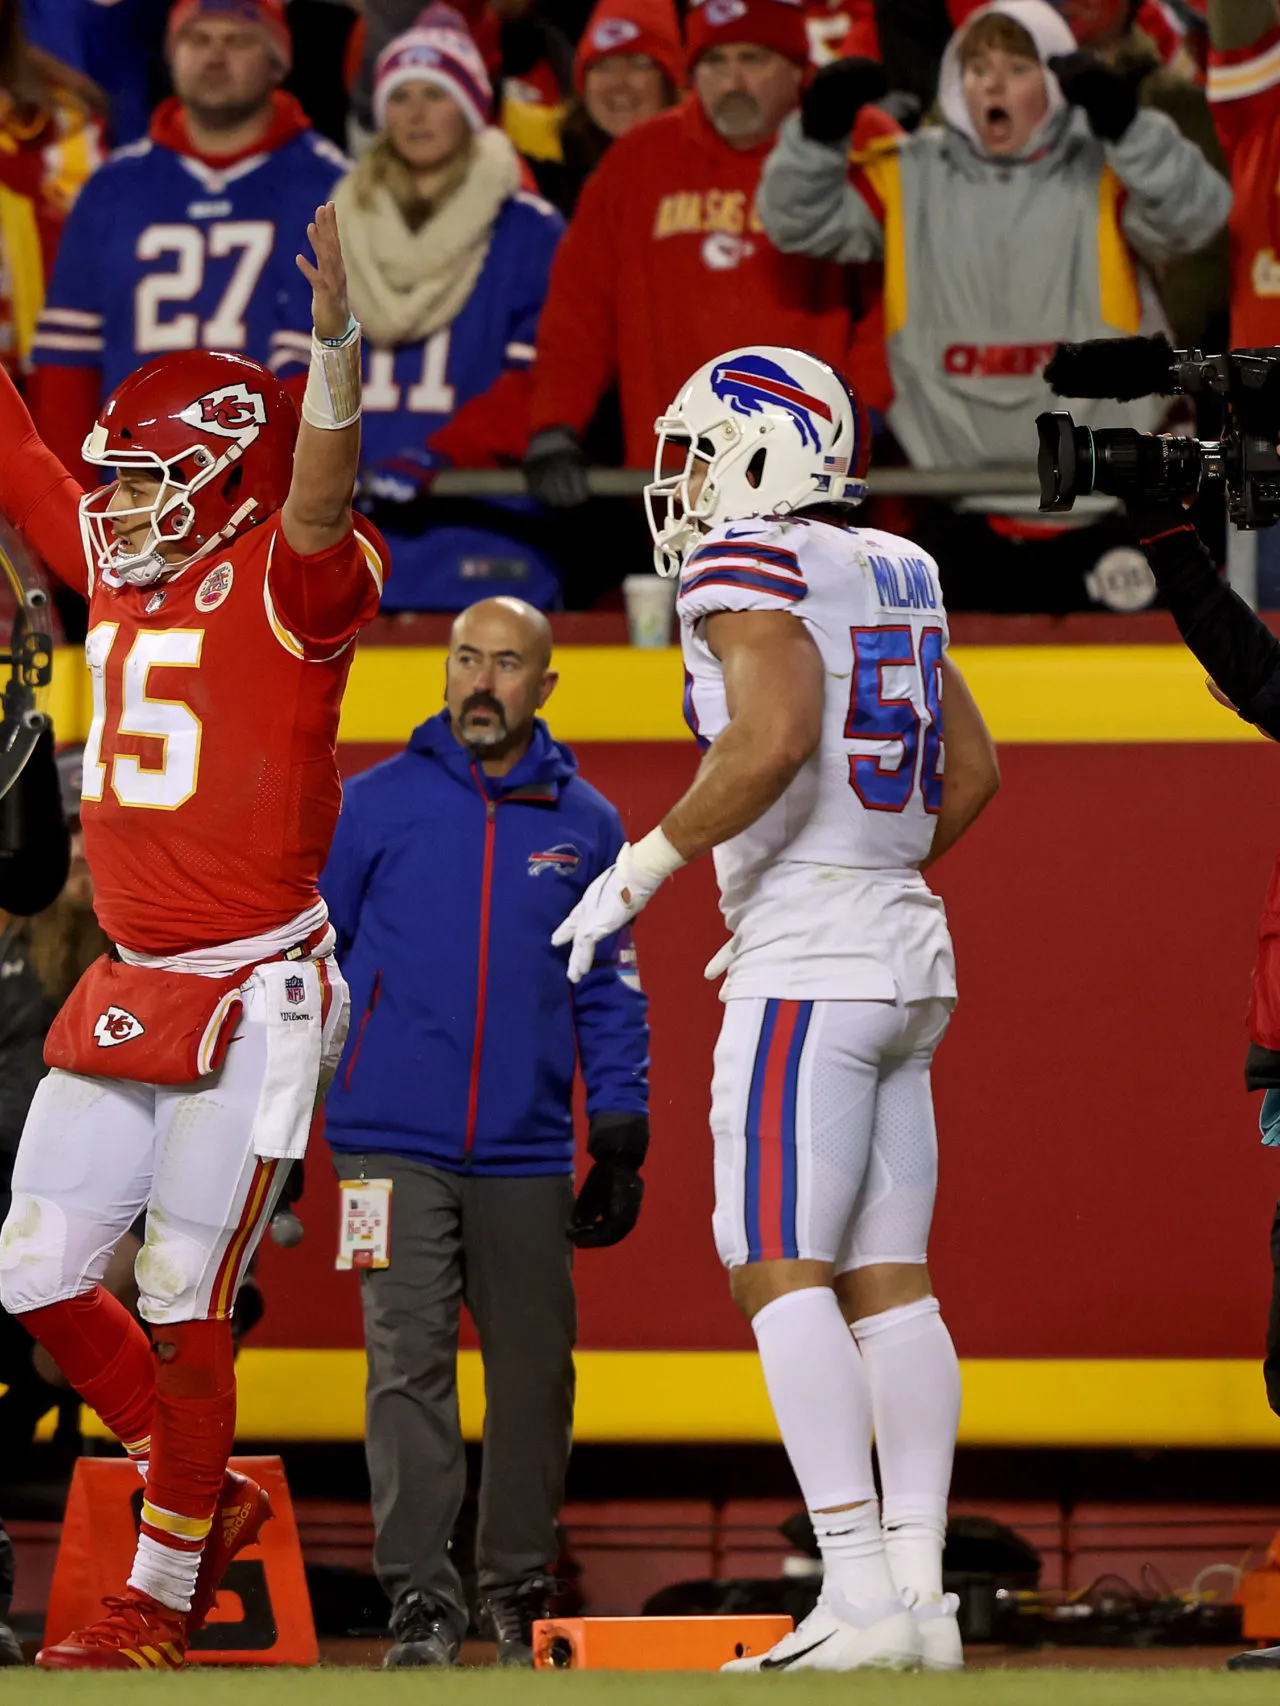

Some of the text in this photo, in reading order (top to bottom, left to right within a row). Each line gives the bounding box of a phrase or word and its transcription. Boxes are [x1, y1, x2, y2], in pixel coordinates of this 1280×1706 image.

[134, 220, 275, 353] 27
[942, 341, 1057, 376] CHIEF
[199, 395, 256, 430] KC
[867, 556, 937, 609] MILANO
[81, 620, 205, 811] 15
[287, 988, 304, 1001] NFL
[104, 1014, 133, 1040] KC
[280, 1011, 310, 1021] Wilson
[224, 1502, 251, 1548] adidas
